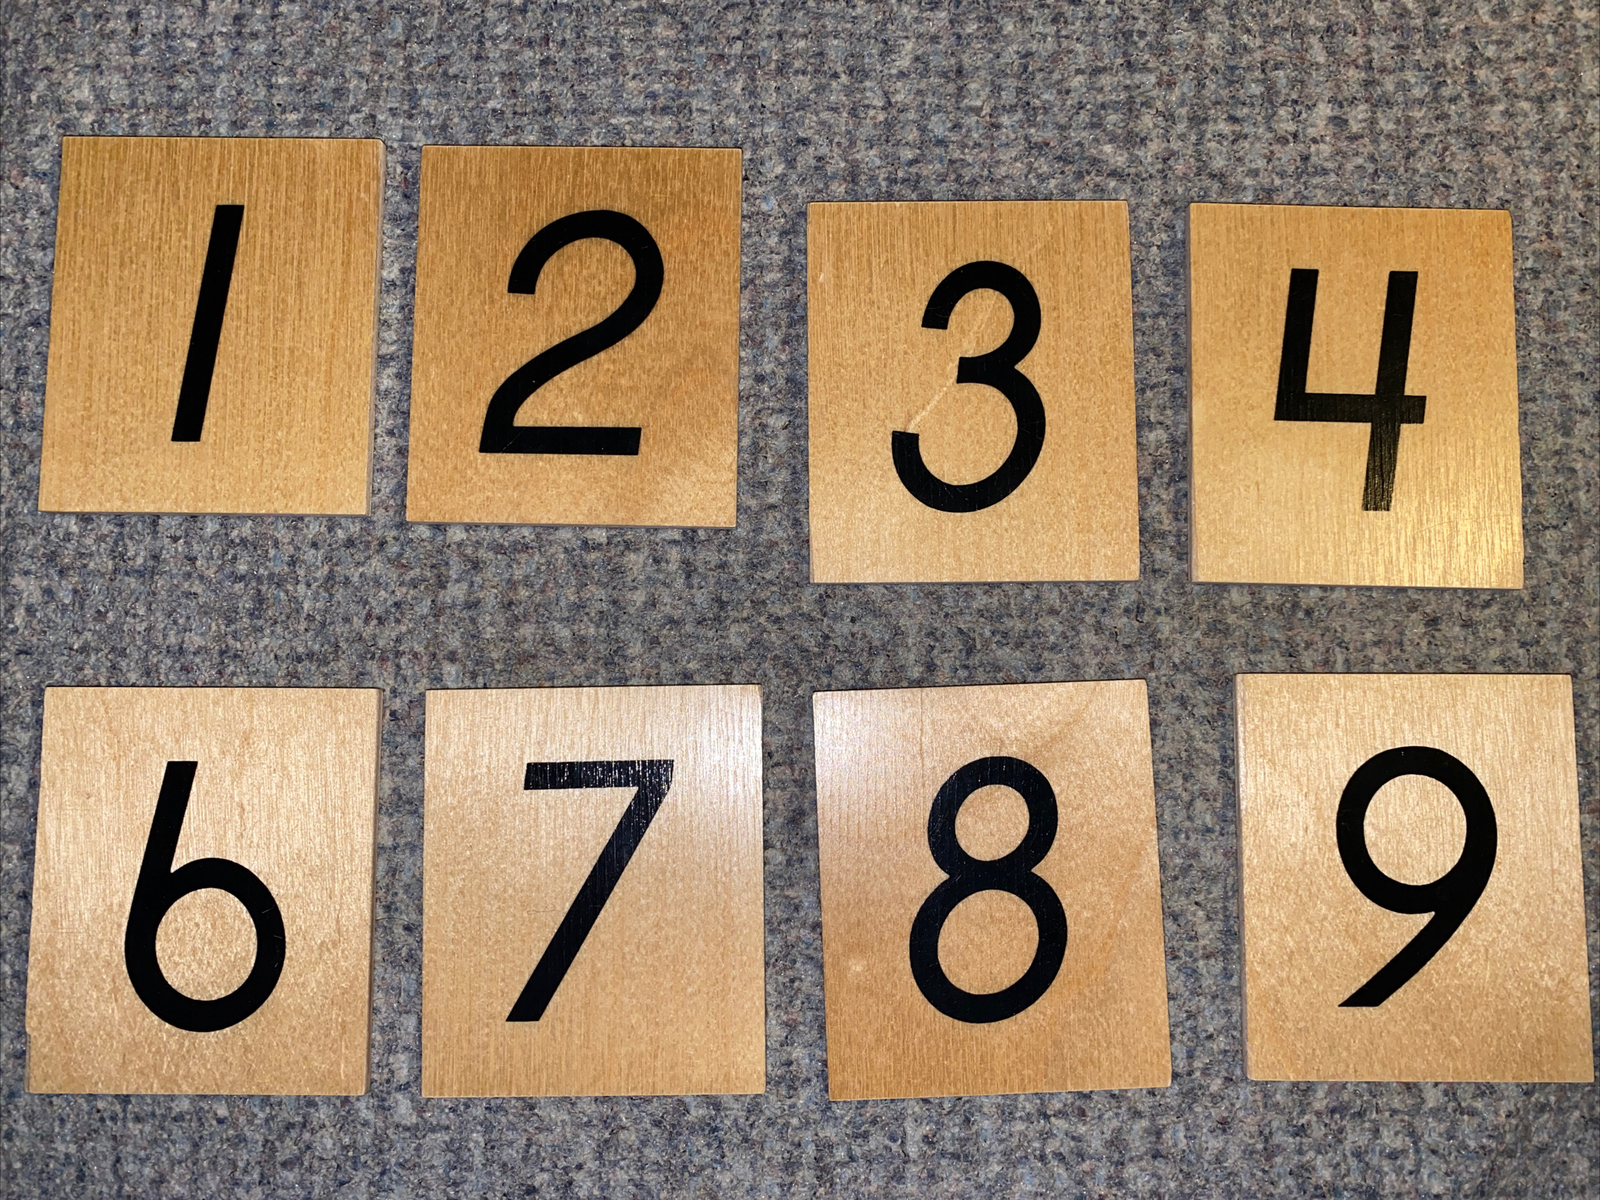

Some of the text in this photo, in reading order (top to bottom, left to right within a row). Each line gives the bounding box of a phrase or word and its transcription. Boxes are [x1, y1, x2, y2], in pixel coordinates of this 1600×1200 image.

[171, 204, 244, 442] 1
[479, 209, 665, 455] 2
[891, 260, 1046, 513] 3
[1274, 268, 1427, 512] 4
[125, 760, 286, 1033] 6
[507, 759, 675, 1022] 7
[910, 756, 1067, 1023] 8
[1337, 746, 1498, 1008] 9
